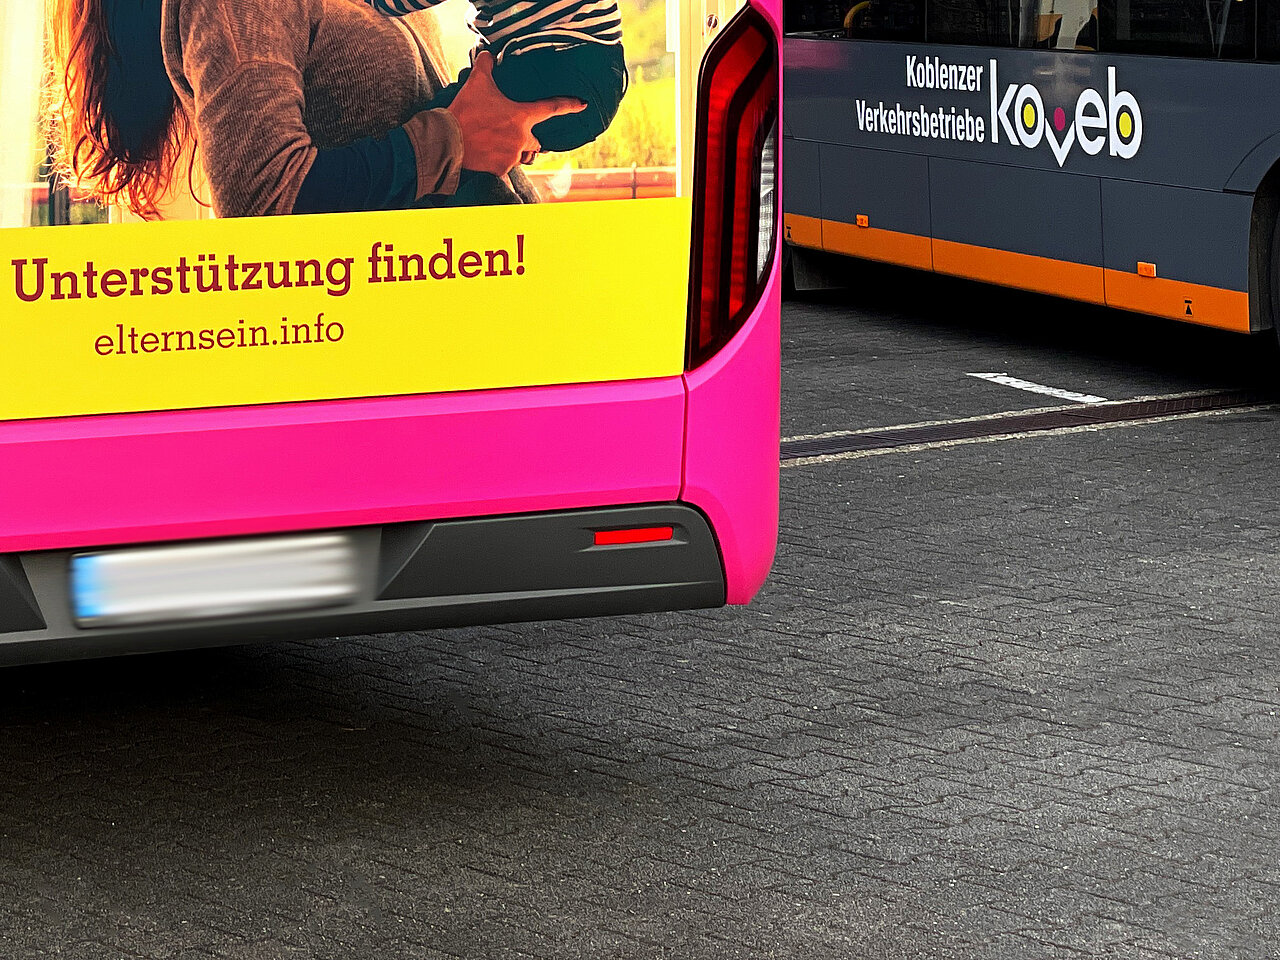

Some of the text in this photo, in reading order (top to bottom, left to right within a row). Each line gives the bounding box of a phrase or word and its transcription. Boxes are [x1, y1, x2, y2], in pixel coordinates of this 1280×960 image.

[855, 99, 985, 143] Verkehrsbetriebe
[905, 54, 1144, 168] Koblenzer koveb
[11, 251, 355, 303] Unterstützung
[367, 234, 528, 284] finden!
[93, 312, 346, 357] elternsein.info
